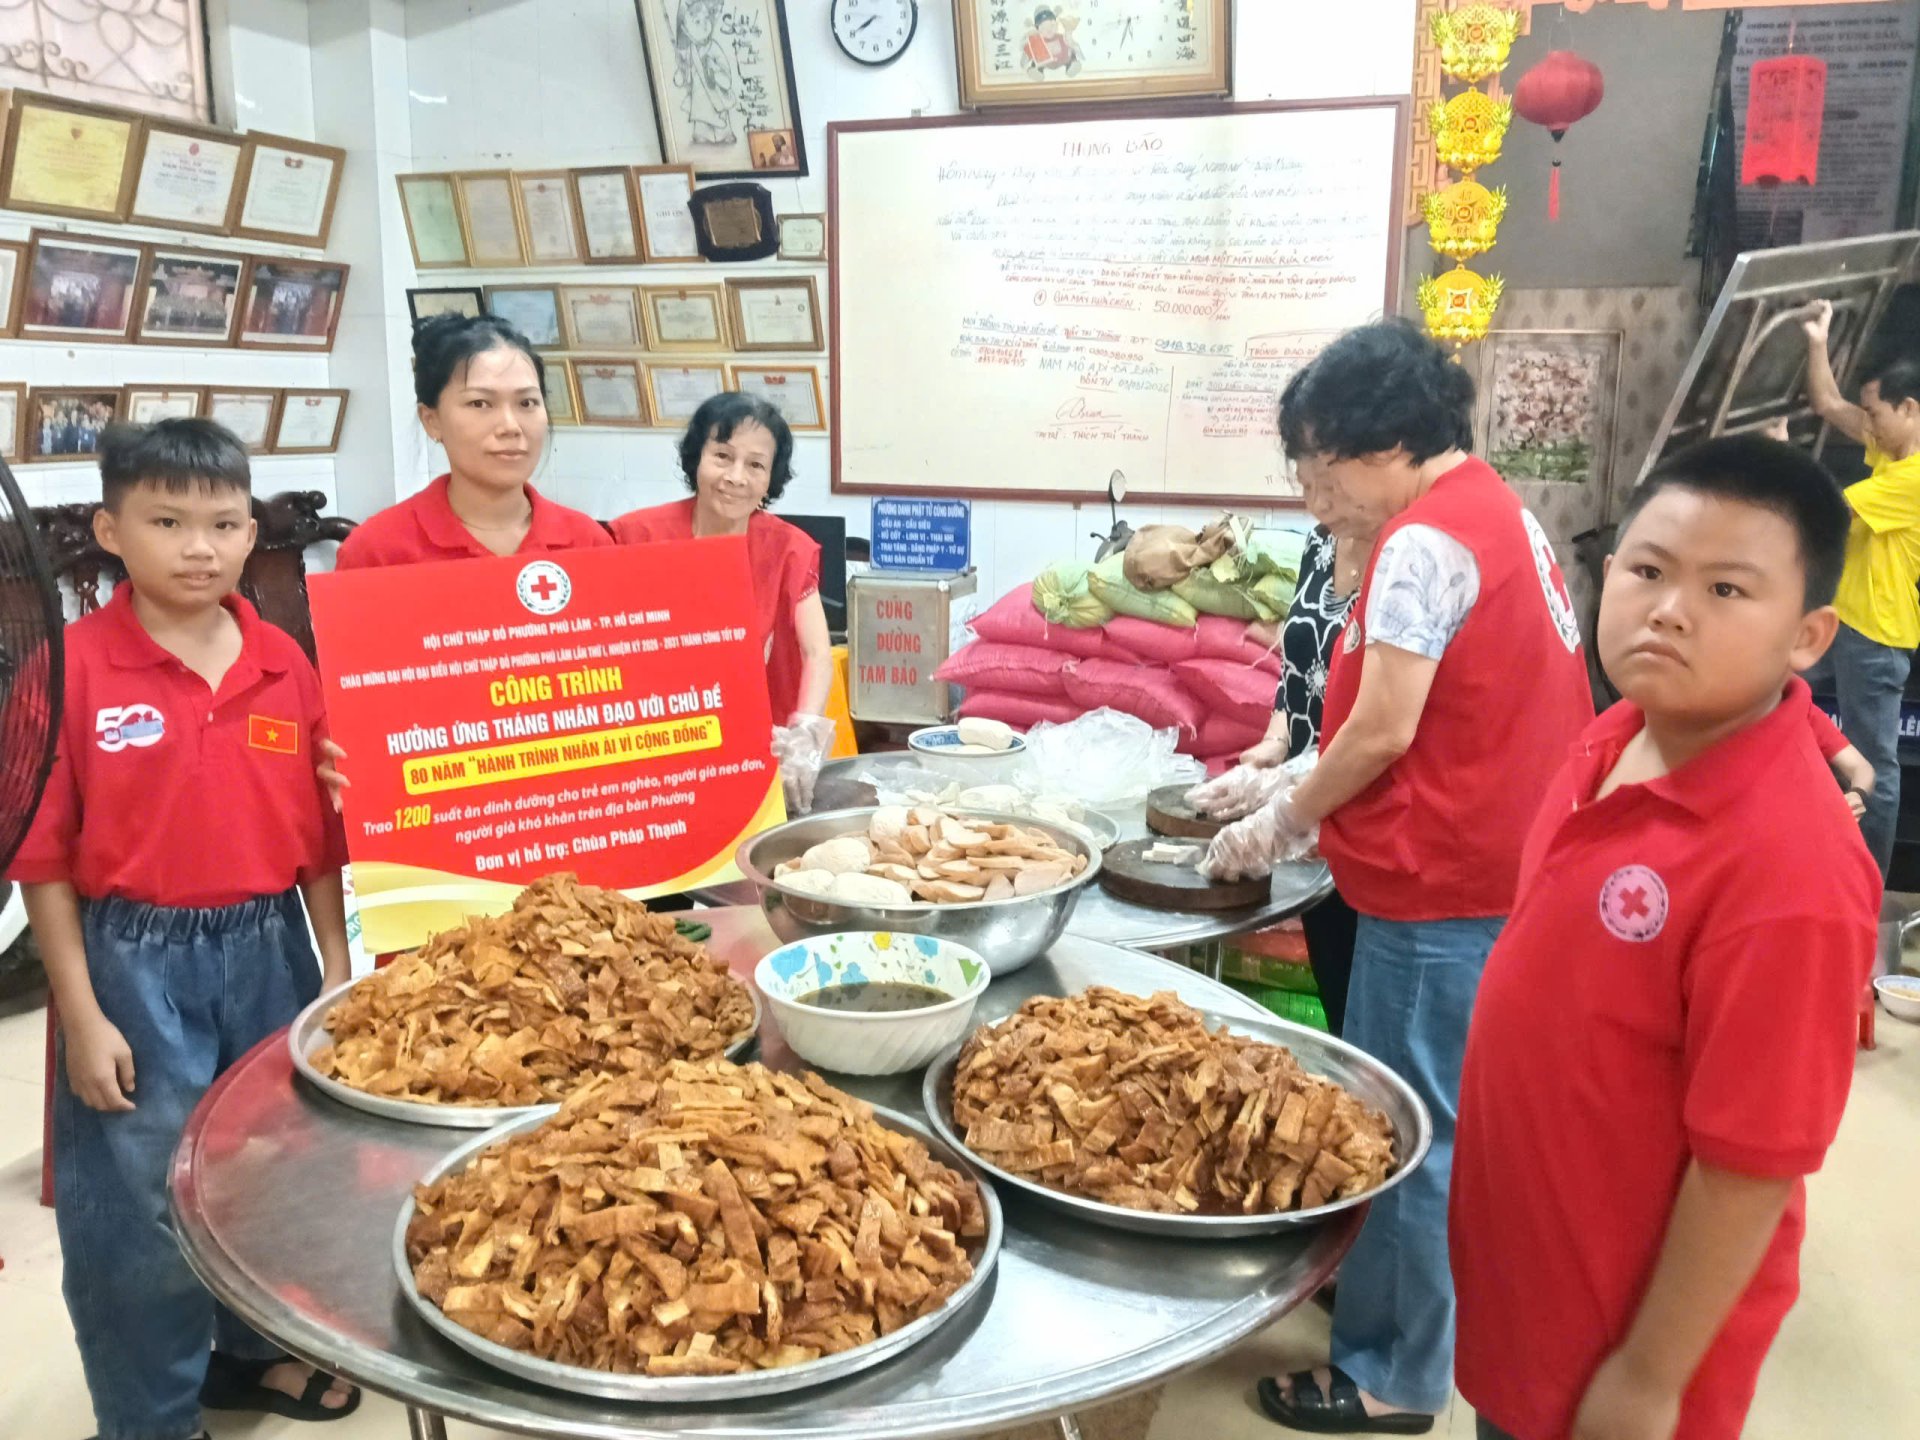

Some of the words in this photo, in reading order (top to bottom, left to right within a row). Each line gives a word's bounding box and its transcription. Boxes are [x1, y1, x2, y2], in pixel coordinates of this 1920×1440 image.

[423, 633, 440, 651] HỘI
[443, 631, 464, 647] CHỮ
[466, 628, 490, 645] THẬP
[492, 624, 507, 641] ĐỎ
[509, 623, 549, 639] PHƯỜNG
[550, 618, 569, 634] PHÚ
[571, 617, 592, 633] LÂM
[599, 616, 613, 629] TP.
[614, 610, 627, 627] HỒ
[629, 611, 645, 625] CHÍ
[646, 609, 670, 624] MINH
[489, 674, 553, 707] CÔNG
[556, 664, 623, 699] TRÌNH
[386, 722, 449, 756] HƯỞNG
[452, 719, 490, 746] ỨNG
[492, 711, 550, 739] THÁNG
[552, 703, 599, 731] NHÂN
[602, 700, 635, 727] ĐẠO
[638, 692, 665, 719] VỚI
[668, 685, 700, 715] CHỦ
[702, 681, 723, 710] ĐỀ
[410, 767, 429, 785] 80
[431, 759, 466, 782] NĂM
[518, 745, 560, 769] TRÌNH
[562, 738, 601, 763] NHÂN
[603, 735, 617, 755] ÁI
[619, 735, 632, 753] VÌ
[635, 729, 671, 753] CỘNG
[363, 820, 393, 837] Trao
[395, 803, 431, 831] 1200
[433, 805, 462, 824] suất
[483, 799, 513, 815] dinh
[515, 792, 556, 812] dưỡng
[557, 786, 580, 804] cho
[581, 783, 599, 799] trẻ
[601, 782, 620, 796] em
[621, 776, 661, 795] nghèo,
[663, 767, 697, 787] người
[699, 765, 717, 782] già
[718, 763, 740, 776] neo
[741, 758, 766, 773] đơn,
[455, 825, 493, 845] người
[495, 821, 516, 839] già
[518, 815, 542, 832] khó
[578, 807, 603, 822] trên
[604, 802, 625, 819] địa
[626, 797, 649, 814] bàn
[651, 790, 696, 809] Phường
[475, 854, 504, 872] Đơn
[506, 850, 521, 868] vị
[523, 842, 542, 864] hỗ
[545, 842, 570, 861] trợ:
[572, 834, 608, 855] Chùa
[609, 826, 645, 848] Pháp
[647, 819, 687, 841] Thạnh
